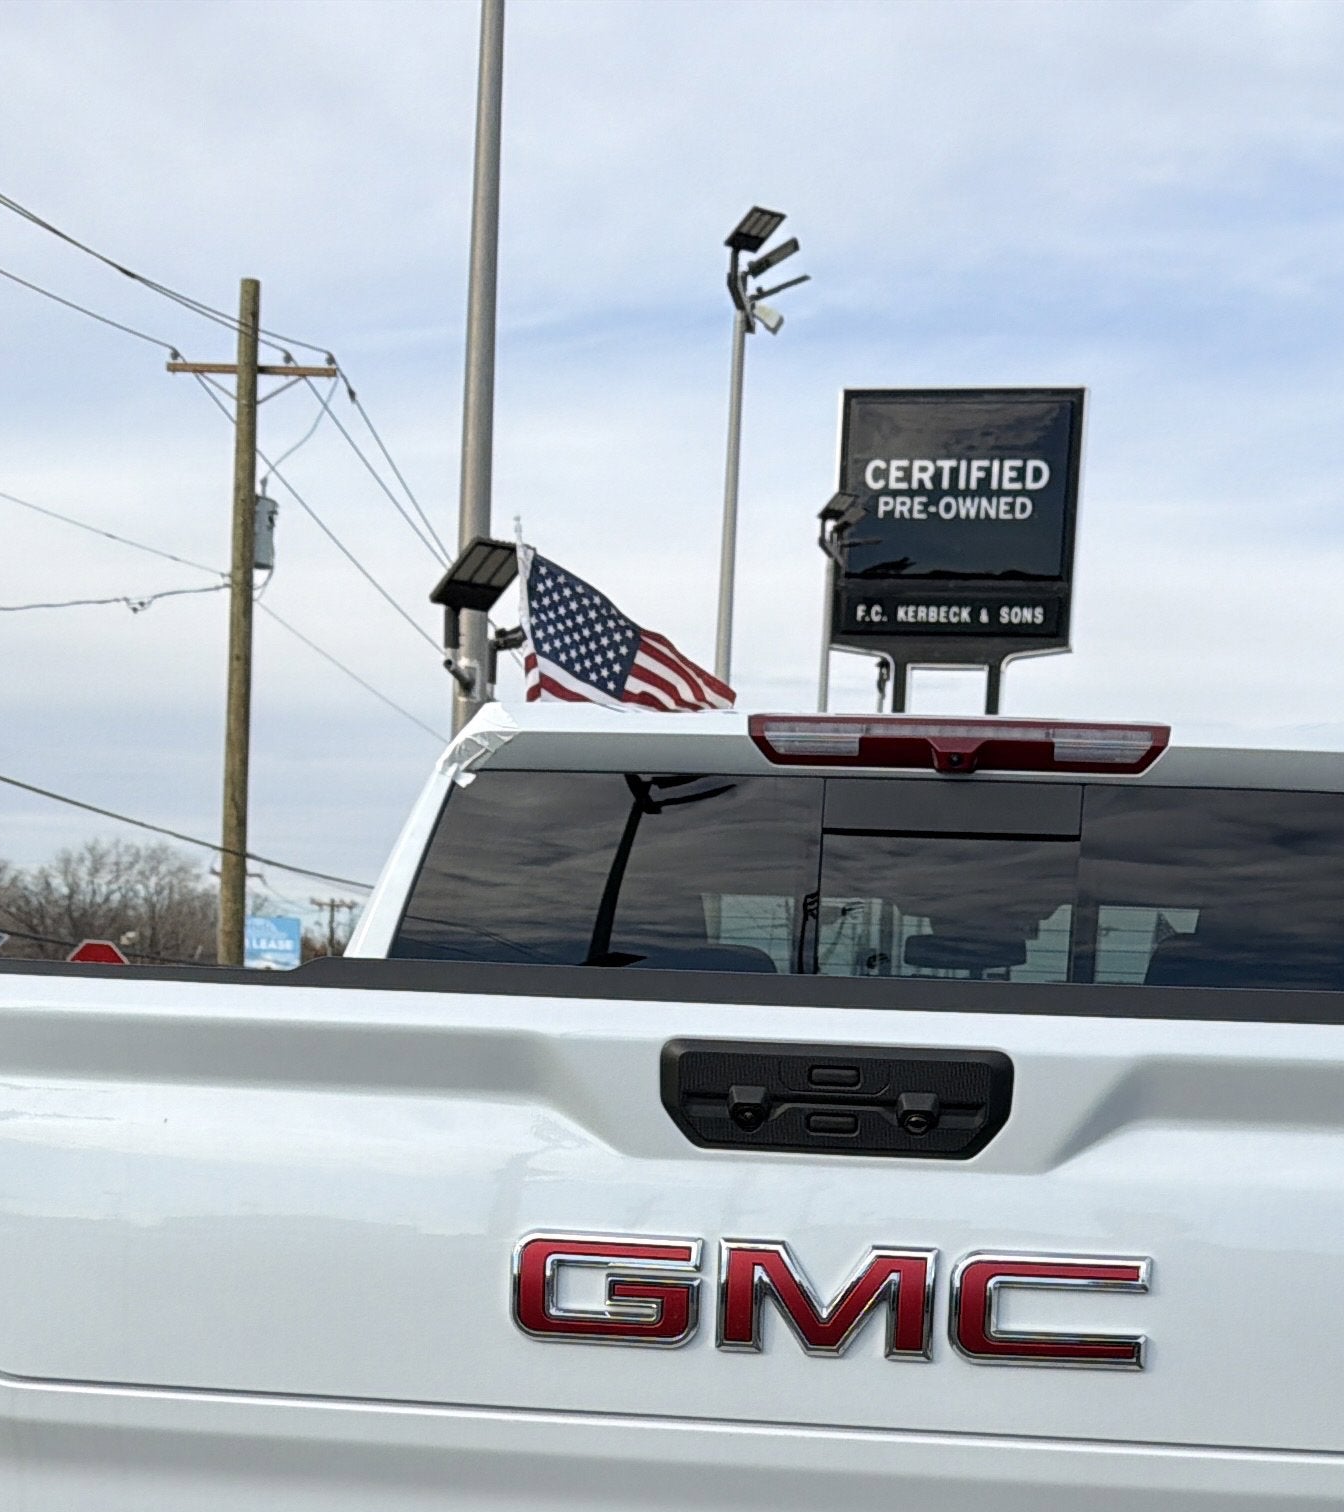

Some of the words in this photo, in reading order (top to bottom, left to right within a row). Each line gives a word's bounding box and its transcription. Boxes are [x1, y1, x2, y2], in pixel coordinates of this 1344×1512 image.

[864, 458, 1051, 490] CERTIFIED
[876, 496, 1033, 520] PRE-OWNED
[856, 604, 888, 622] F.C.
[896, 605, 972, 624] KERBECK
[999, 606, 1044, 624] SONS
[252, 938, 294, 951] LEASE
[510, 1227, 1153, 1372] GMC
